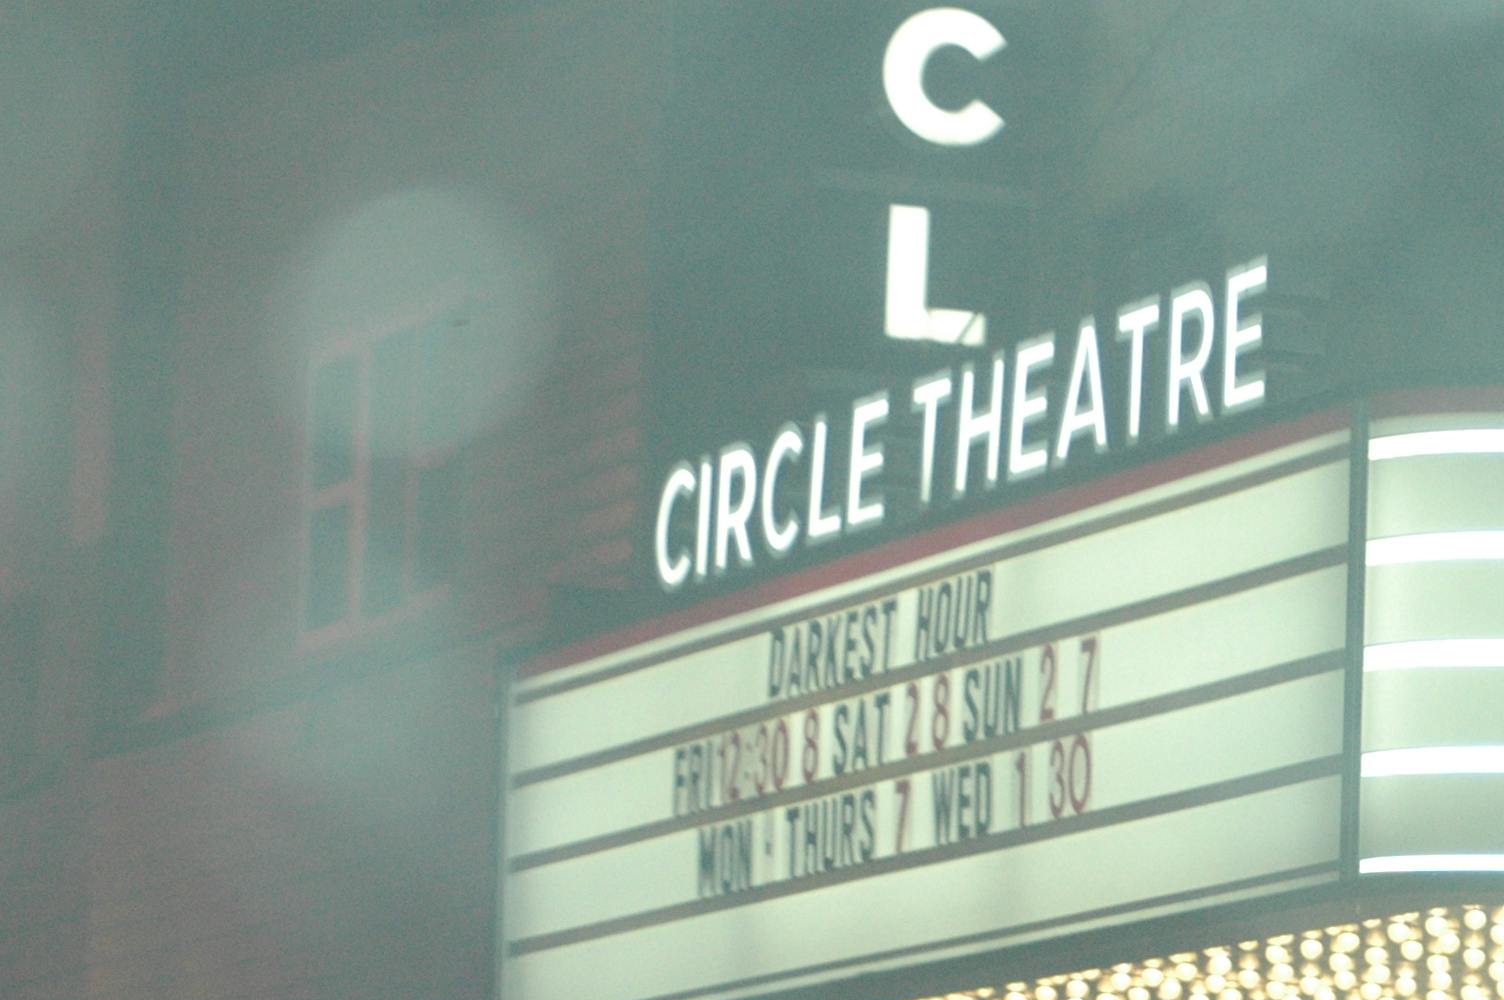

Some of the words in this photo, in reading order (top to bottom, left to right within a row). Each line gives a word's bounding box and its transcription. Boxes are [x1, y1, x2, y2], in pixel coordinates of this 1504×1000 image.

[654, 391, 890, 590] CIRCLE
[911, 254, 1269, 502] THEATRE
[768, 600, 898, 699] DARKEST
[914, 569, 992, 663] HOUR
[673, 740, 713, 819] FRI
[801, 706, 820, 785] 8
[832, 691, 892, 777] SAT
[904, 681, 920, 756] 2
[931, 671, 949, 752] 8
[963, 655, 1023, 744] SUN
[1039, 643, 1056, 722] 2
[1080, 634, 1098, 716] 7
[698, 817, 753, 899] MON
[786, 787, 875, 879] THURS
[894, 779, 911, 856] 7
[932, 761, 993, 848] WED
[1014, 750, 1028, 828] 1
[1049, 733, 1092, 821] 30
